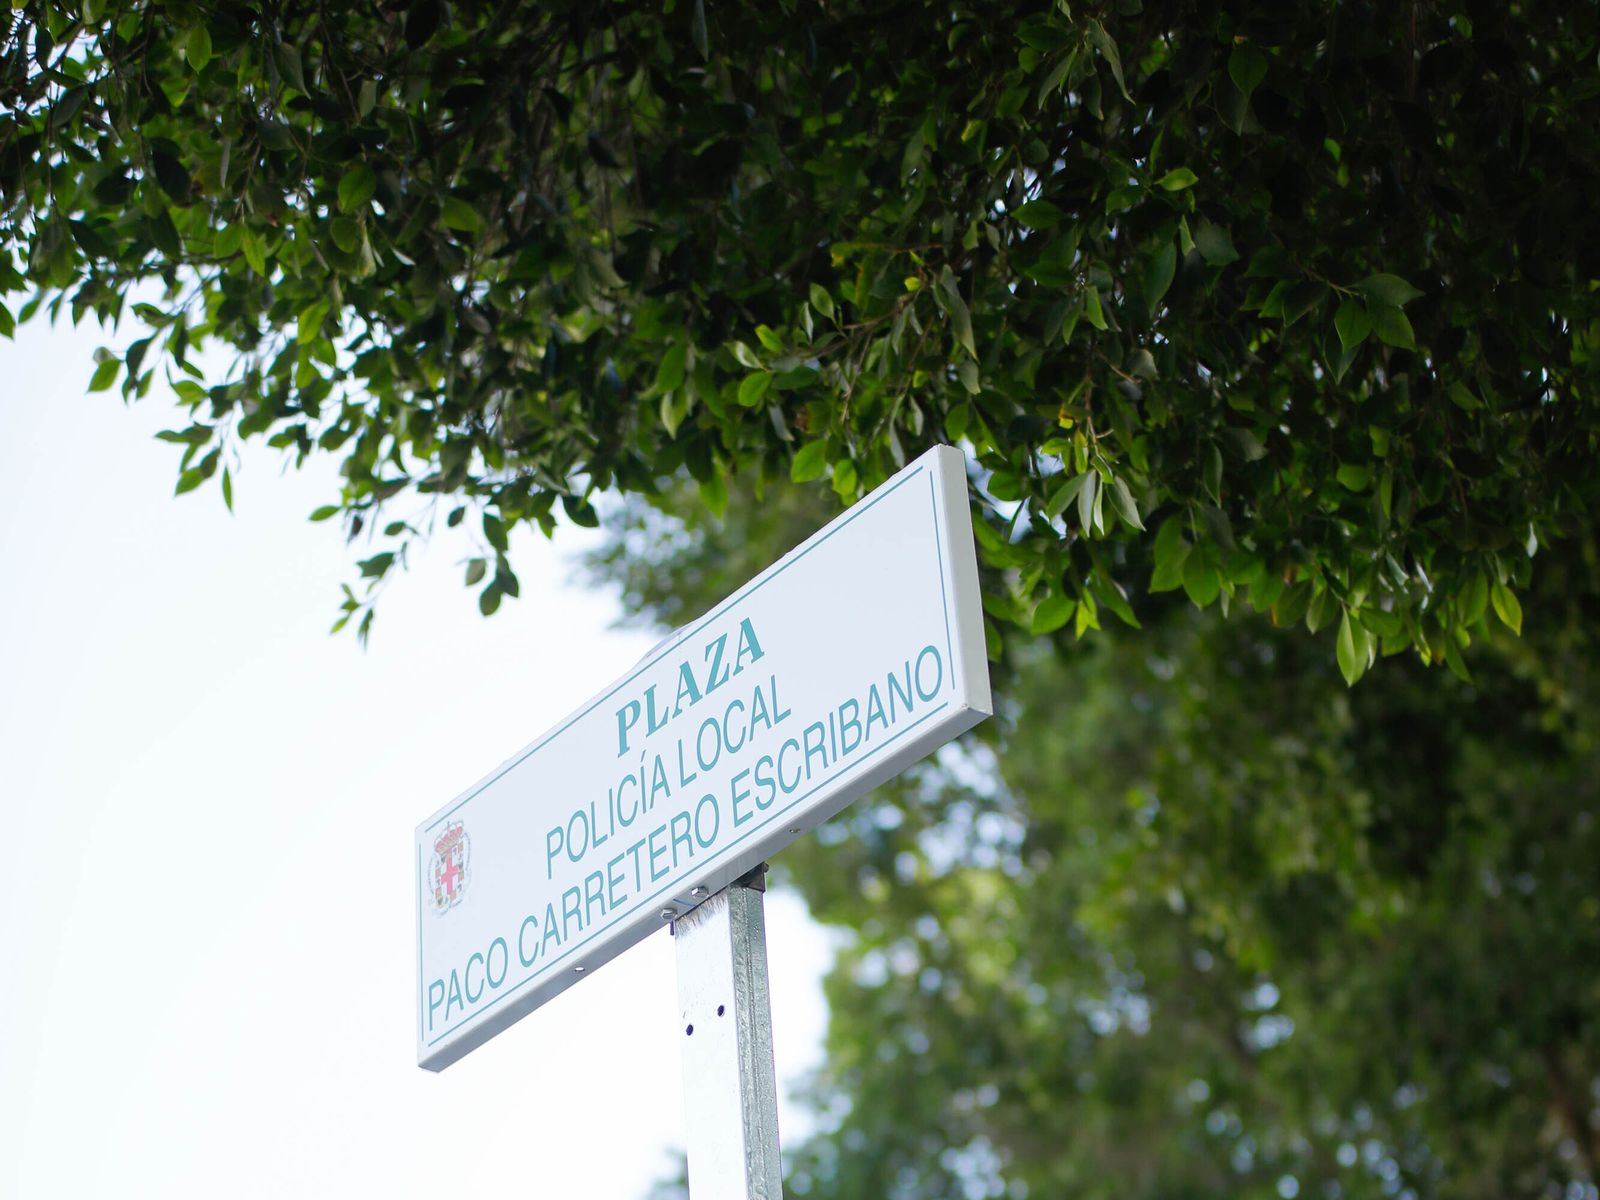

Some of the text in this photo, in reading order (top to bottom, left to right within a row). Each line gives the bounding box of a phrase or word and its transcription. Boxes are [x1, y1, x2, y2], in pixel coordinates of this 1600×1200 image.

[547, 674, 791, 880] POLICÍA LOCAL
[616, 617, 765, 757] PLAZA
[428, 644, 943, 1031] PACO CARRETERO ESCRIBANO
